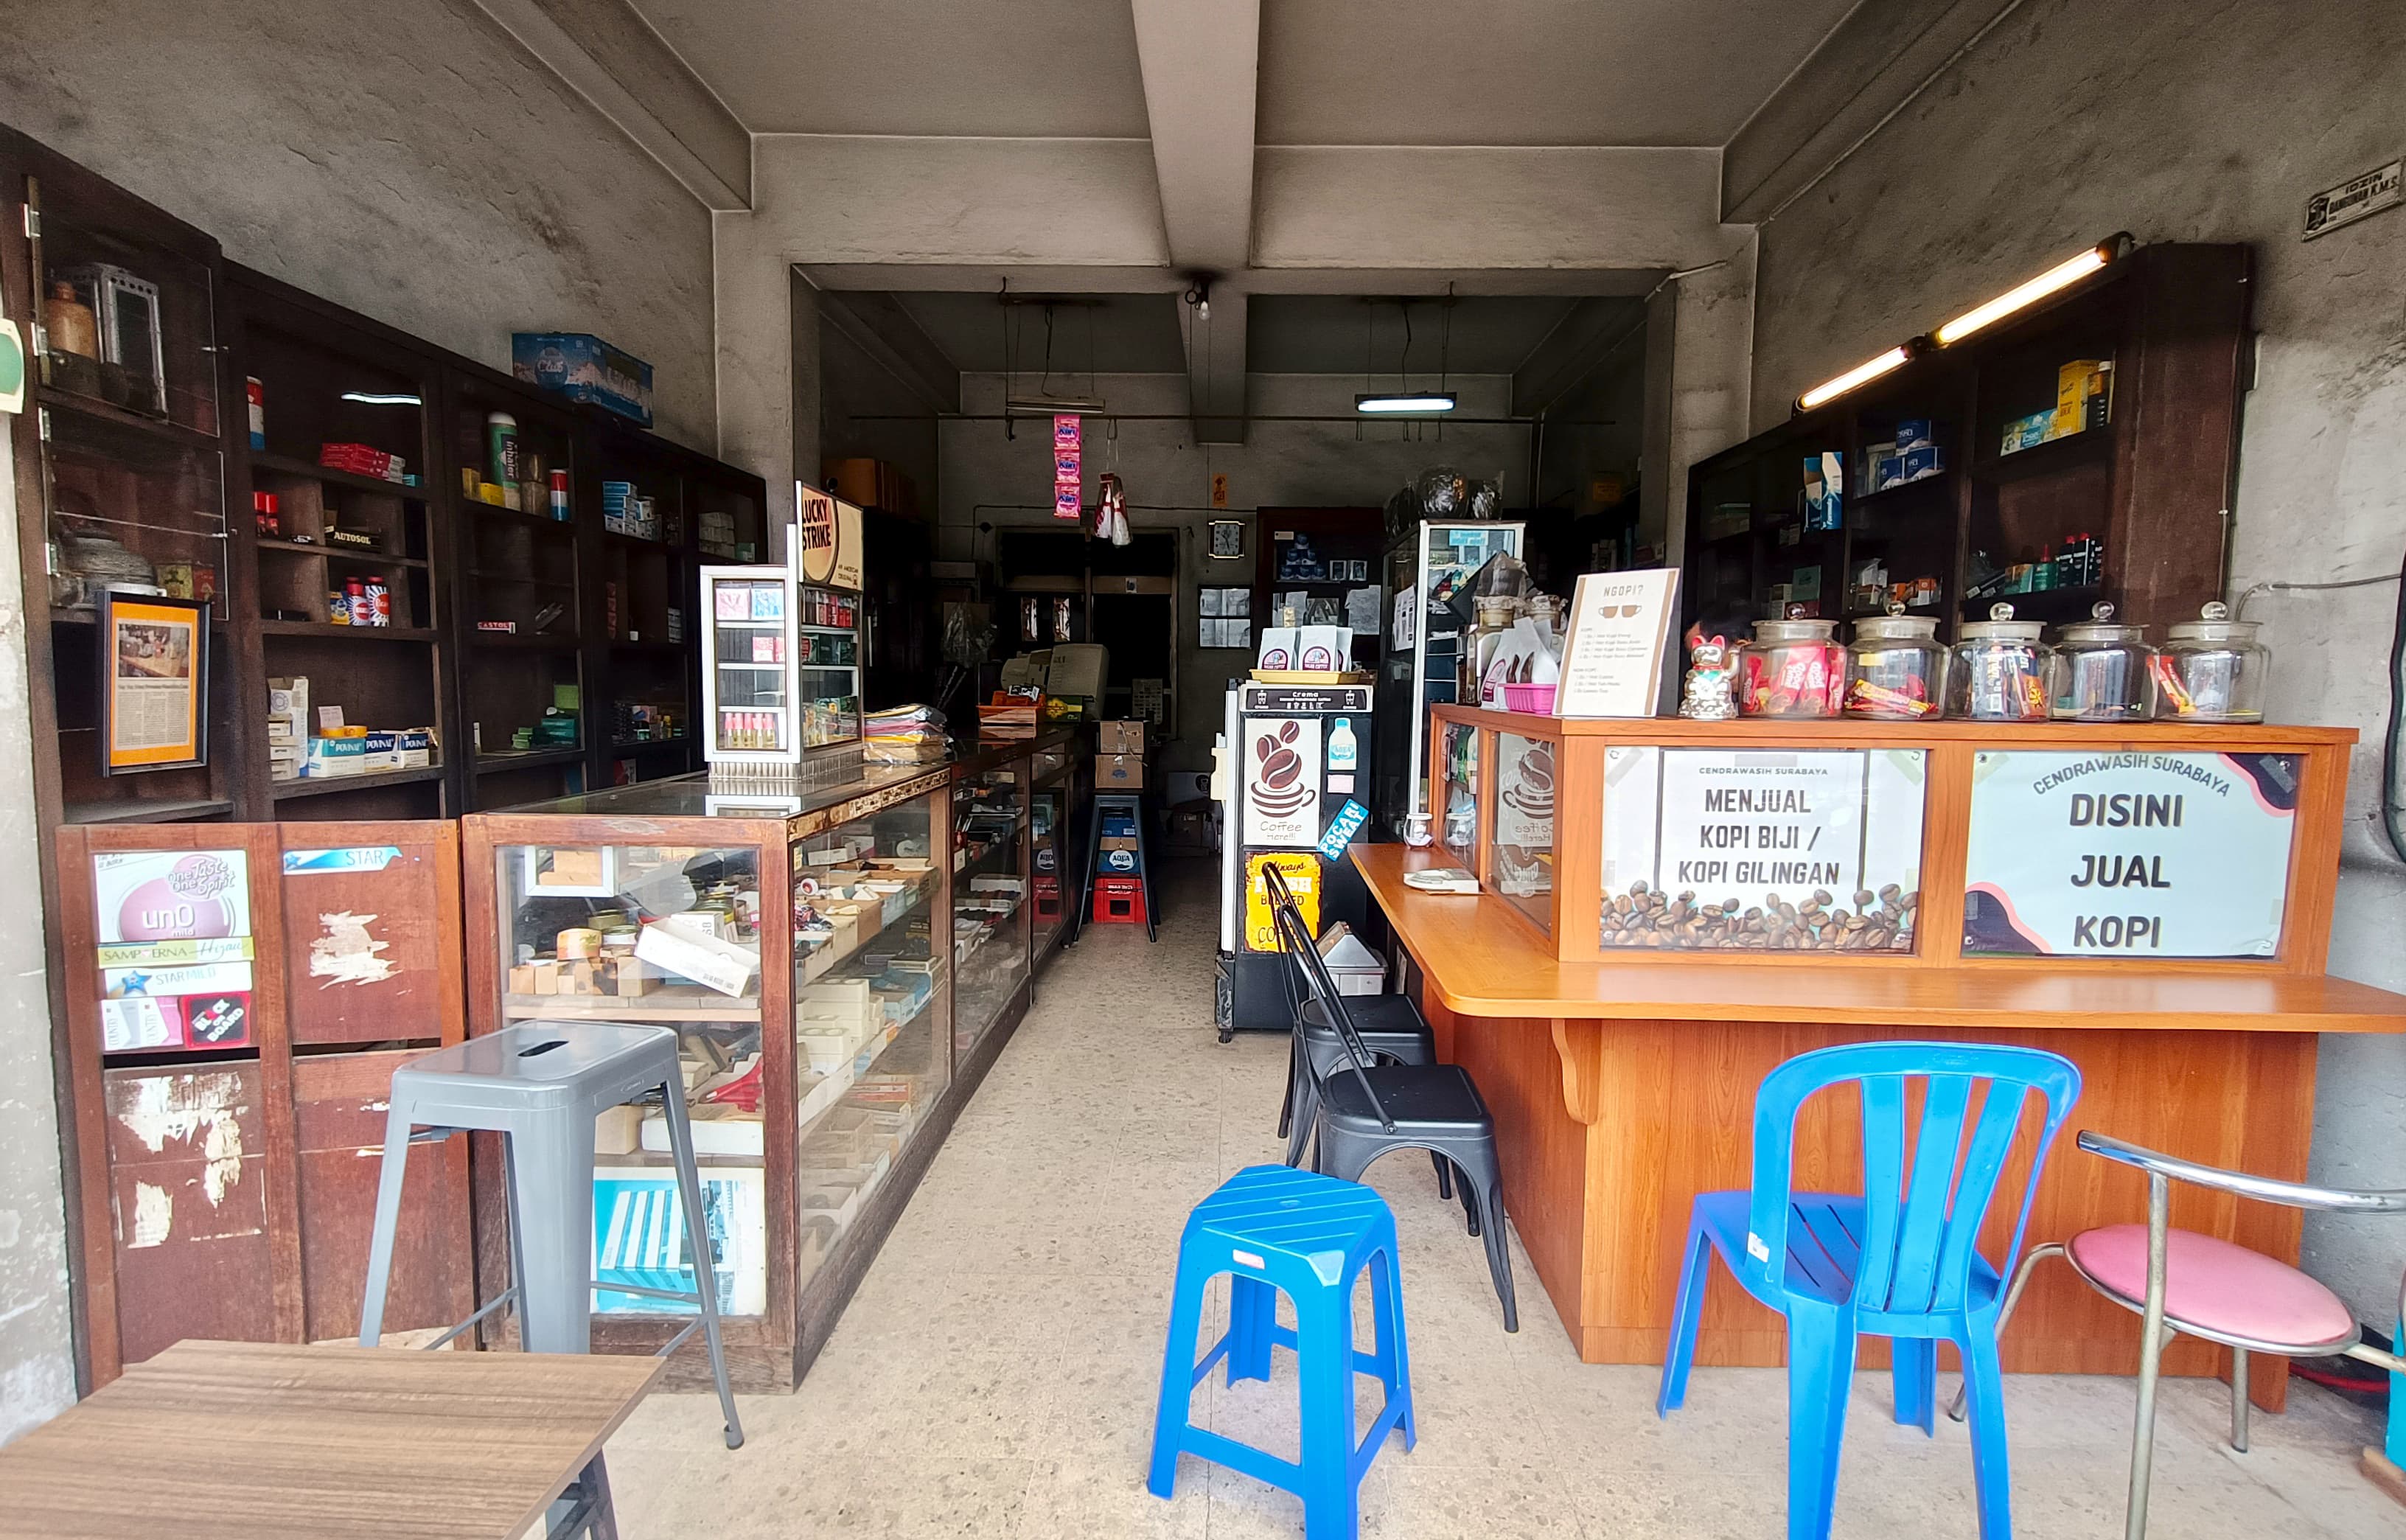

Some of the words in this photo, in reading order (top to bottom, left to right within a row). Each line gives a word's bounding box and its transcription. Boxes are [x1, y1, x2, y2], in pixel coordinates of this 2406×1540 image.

[504, 440, 515, 478] Inhaler
[803, 498, 827, 523] LUCKY
[333, 531, 372, 546] AUTOSOL
[803, 524, 831, 551] STRIKE
[1603, 585, 1644, 596] NGOPI?
[1775, 767, 1828, 776] SURABAYA
[2034, 754, 2149, 795] CENDRAWASIH
[2152, 756, 2231, 797] SURABAYA
[1705, 789, 1811, 814] MENJUAL
[2070, 793, 2183, 826] DISINI
[1260, 821, 1303, 832] Coffee
[1321, 803, 1359, 853] POCARI
[1328, 812, 1364, 858] SWEAT
[1701, 826, 1749, 849] KOPI
[1758, 826, 1799, 849] BIJI
[1807, 826, 1821, 851] /
[167, 871, 192, 882] One
[192, 857, 229, 879] Taste
[346, 849, 385, 866] STAR
[1678, 861, 1728, 884] KOPI
[1735, 862, 1840, 885] GILINGAN
[2071, 855, 2172, 888] JUAL
[171, 879, 197, 893] One
[197, 871, 235, 899] Spirit
[2074, 916, 2161, 948] KOPI
[104, 947, 188, 961] SAMPERNA
[156, 972, 184, 985] STAR
[206, 1008, 245, 1042] BOARD
